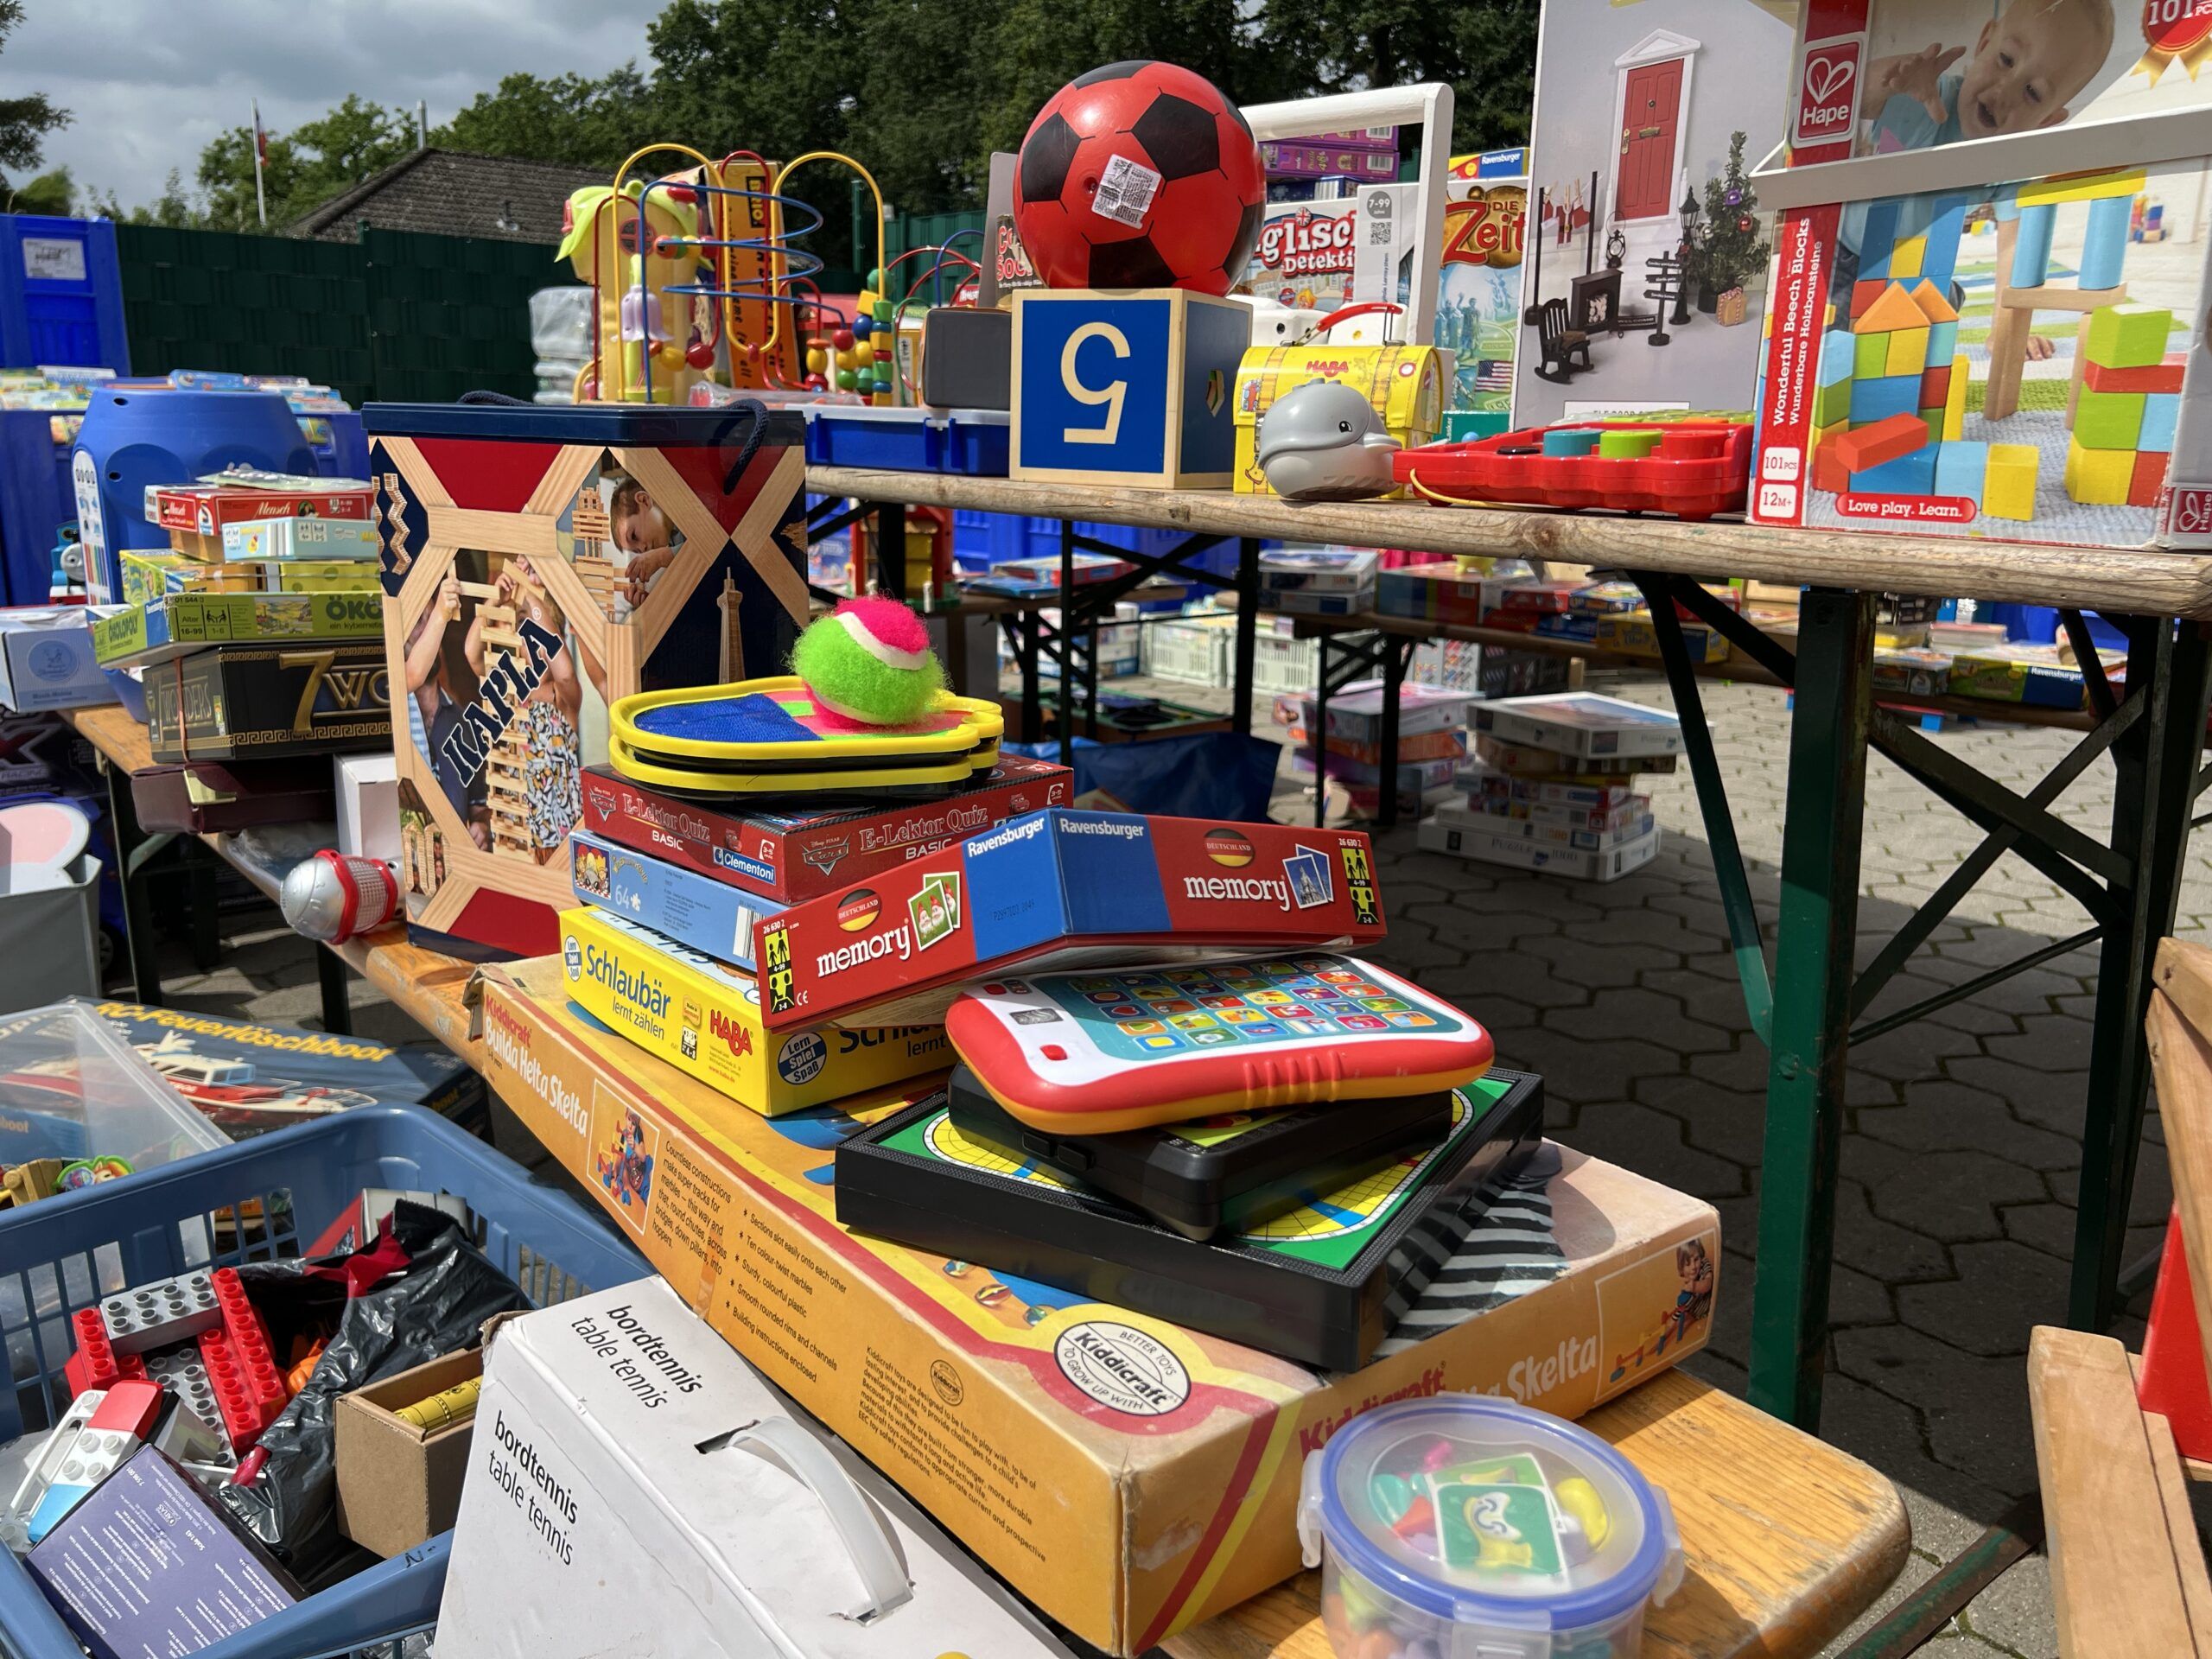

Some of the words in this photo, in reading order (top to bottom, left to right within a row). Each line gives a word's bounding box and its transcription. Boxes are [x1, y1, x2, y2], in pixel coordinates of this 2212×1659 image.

[2148, 0, 2193, 26] 101
[2195, 4, 2212, 16] PC
[1802, 105, 1849, 126] Hape
[1482, 153, 1521, 164] Ravensburger
[749, 179, 765, 222] BRIO
[1369, 199, 1390, 208] 7-99
[1493, 201, 1519, 211] DIE
[1255, 210, 1357, 262] glisc
[1442, 200, 1525, 265] Zeit
[1791, 218, 1809, 274] Blocks
[1285, 252, 1355, 272] Detekti
[1783, 278, 1802, 334] Beech
[1789, 341, 1808, 426] Wunderbare
[1800, 240, 1822, 338] Holzbausteine
[1060, 321, 1131, 445] 5
[1306, 360, 1349, 377] HABA
[1773, 338, 1793, 427] Wonderful
[253, 501, 291, 518] Mensch
[1763, 492, 1792, 507] 12M+
[1848, 499, 1878, 512] Love
[1881, 501, 1915, 517] play.
[1919, 503, 1962, 517] Learn.
[2199, 493, 2212, 530] Hape
[326, 595, 382, 620] ÖKO
[278, 650, 335, 734] 7
[441, 617, 564, 788] KAPLA
[623, 792, 677, 831] E-Lektor
[678, 813, 710, 842] Quiz
[859, 817, 945, 851] E-Lektor
[946, 804, 988, 834] Quiz
[968, 818, 1045, 858] Ravensburger
[1060, 818, 1144, 839] Ravensburger
[652, 830, 683, 851] BASIC
[763, 846, 773, 855] 3-5
[1206, 842, 1251, 851] DEUTSCHLAND
[1338, 838, 1346, 847] 26
[724, 853, 774, 881] Clementoni
[614, 884, 630, 910] 64
[838, 899, 879, 919] DEUTSCHLAND
[1184, 876, 1290, 912] memory
[763, 925, 770, 934] 26
[771, 921, 781, 931] 630
[817, 925, 911, 977] memory
[587, 944, 671, 1019] Schlaubär
[97, 1001, 397, 1062] RC-Feuerlöschboot
[486, 994, 531, 1048] Kiddicraft
[613, 995, 632, 1022] lernt
[634, 1012, 664, 1040] zählen
[710, 1009, 753, 1057] HABA
[787, 1037, 810, 1055] Lern
[789, 1049, 817, 1070] Spiel
[907, 1035, 946, 1058] lernt
[486, 1015, 518, 1071] Builda
[520, 1046, 548, 1101] Helta
[549, 1075, 588, 1137] Skelta
[793, 1061, 819, 1083] Spaß
[664, 1159, 677, 1177] make
[677, 1173, 693, 1190] super
[692, 1185, 709, 1206] tracks
[710, 1198, 721, 1213] for
[665, 1141, 691, 1170] Countless
[691, 1166, 731, 1203] constructions
[658, 1189, 669, 1208] that,
[671, 1202, 685, 1221] round
[685, 1217, 705, 1243] chutes,
[707, 1237, 728, 1260] across
[661, 1174, 680, 1198] marbles
[687, 1198, 698, 1213] this
[698, 1209, 710, 1228] way
[711, 1220, 724, 1236] and
[652, 1218, 673, 1249] hoppers.
[655, 1205, 674, 1232] bridges,
[675, 1225, 690, 1245] down
[690, 1241, 709, 1265] pillars,
[710, 1255, 722, 1274] into
[750, 1213, 773, 1237] Sections
[773, 1231, 785, 1246] slot
[785, 1240, 800, 1261] easily
[801, 1255, 815, 1270] onto
[815, 1264, 830, 1281] each
[830, 1277, 847, 1294] other
[746, 1236, 757, 1249] Ten
[757, 1244, 790, 1276] colour-twist
[790, 1272, 813, 1295] marbles
[742, 1259, 762, 1283] Sturdy,
[762, 1277, 788, 1302] colourful
[788, 1295, 808, 1318] plastic
[607, 1305, 702, 1394] bordtennis
[733, 1306, 755, 1334] Building
[755, 1327, 789, 1360] instructions
[790, 1354, 817, 1382] enclosed
[737, 1284, 760, 1307] Smooth
[760, 1302, 784, 1327] rounded
[784, 1323, 797, 1338] rims
[798, 1332, 810, 1348] and
[810, 1342, 838, 1371] channels
[570, 1316, 619, 1358] table
[609, 1358, 668, 1408] tennis
[1064, 1347, 1075, 1358] TO
[1067, 1358, 1093, 1384] GROW
[1074, 1332, 1167, 1406] Kiddicraft
[1119, 1331, 1157, 1354] BETTER
[1156, 1353, 1177, 1376] TOYS
[1507, 1335, 1599, 1404] Skelta
[863, 1369, 894, 1404] developing
[895, 1392, 919, 1420] abilities.
[1092, 1384, 1109, 1396] UP
[1111, 1395, 1145, 1409] WITH
[858, 1409, 868, 1424] EEC
[869, 1419, 879, 1433] toy
[880, 1428, 897, 1449] safety
[897, 1442, 932, 1479] regulations.
[494, 1410, 578, 1524] bordtennis
[488, 1450, 524, 1509] table
[527, 1496, 573, 1566] tennis
[194, 1537, 206, 1551] Scale
